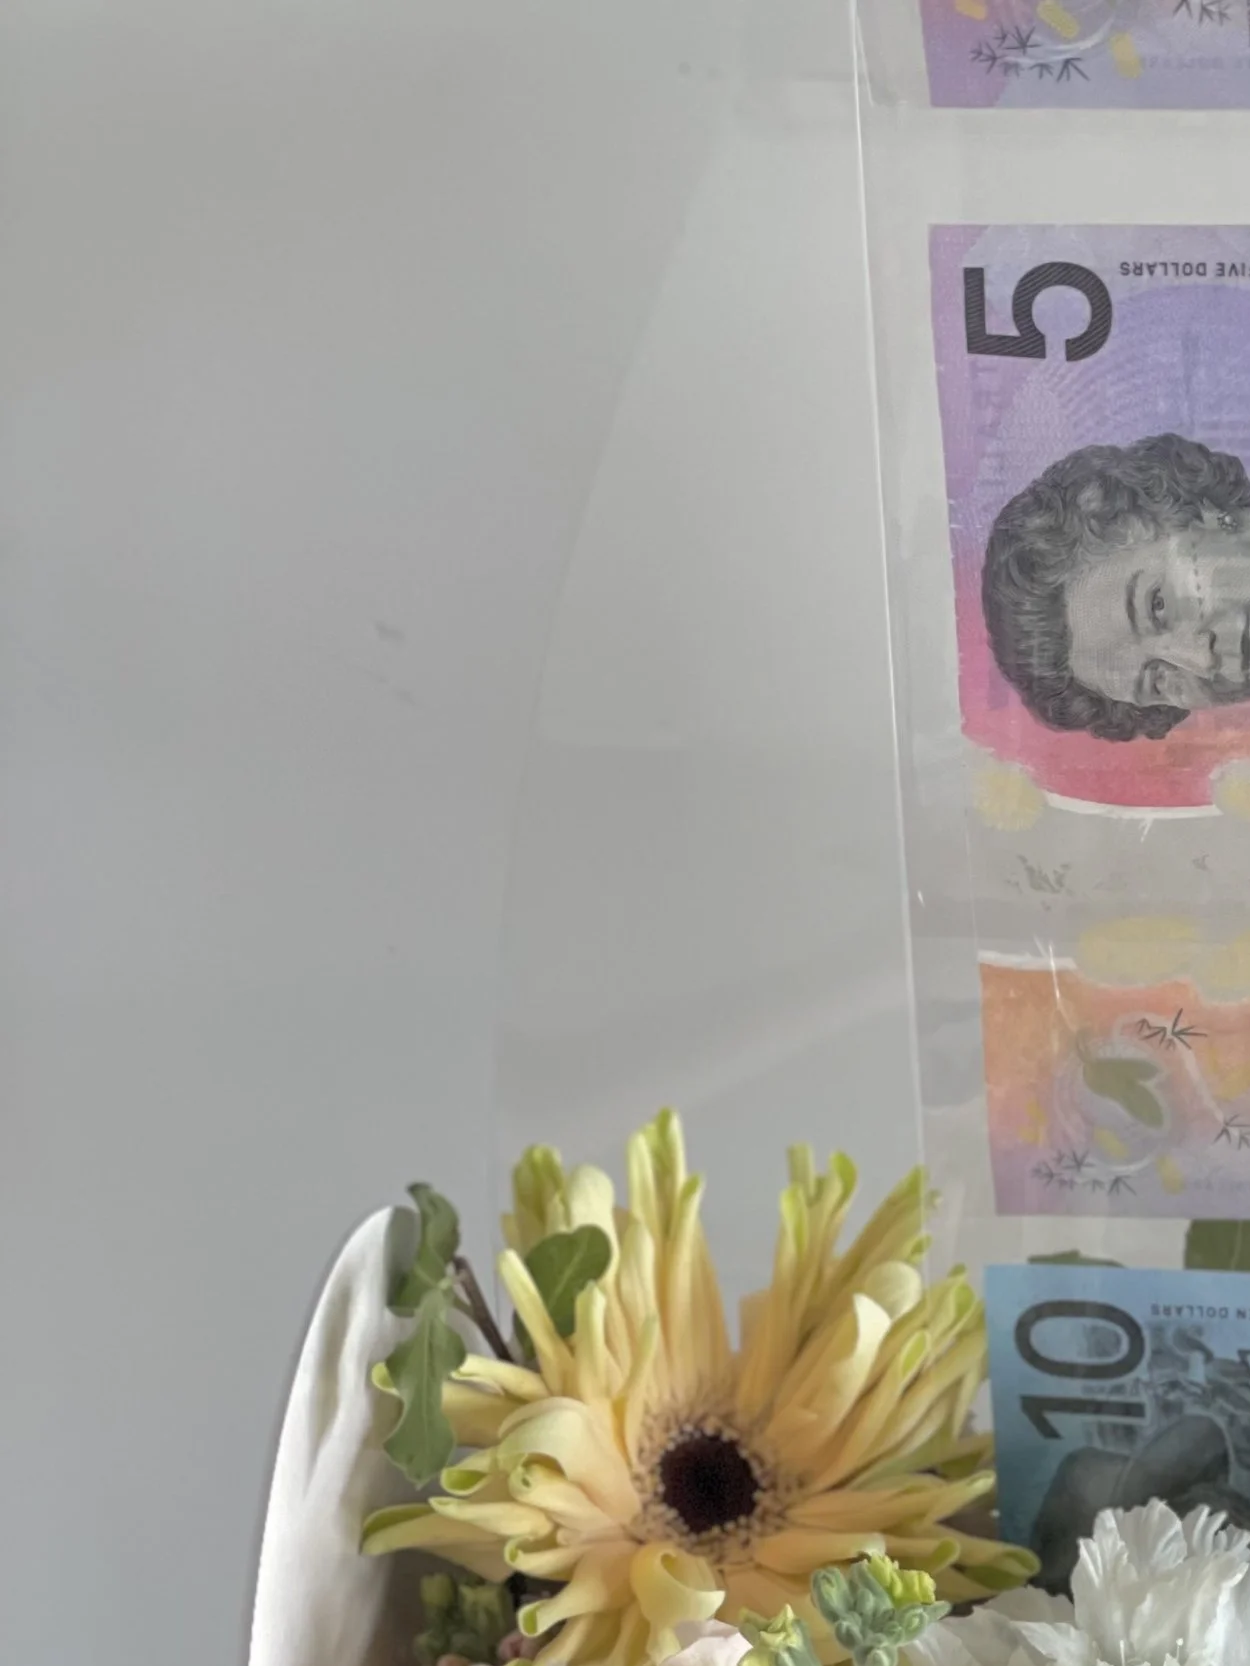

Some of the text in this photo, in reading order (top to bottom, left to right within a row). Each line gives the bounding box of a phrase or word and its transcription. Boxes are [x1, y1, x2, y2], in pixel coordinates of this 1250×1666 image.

[1119, 262, 1208, 277] DOLLARS
[963, 261, 1113, 363] 5
[1150, 1303, 1230, 1320] DOLLARS
[1014, 1299, 1147, 1440] 10
